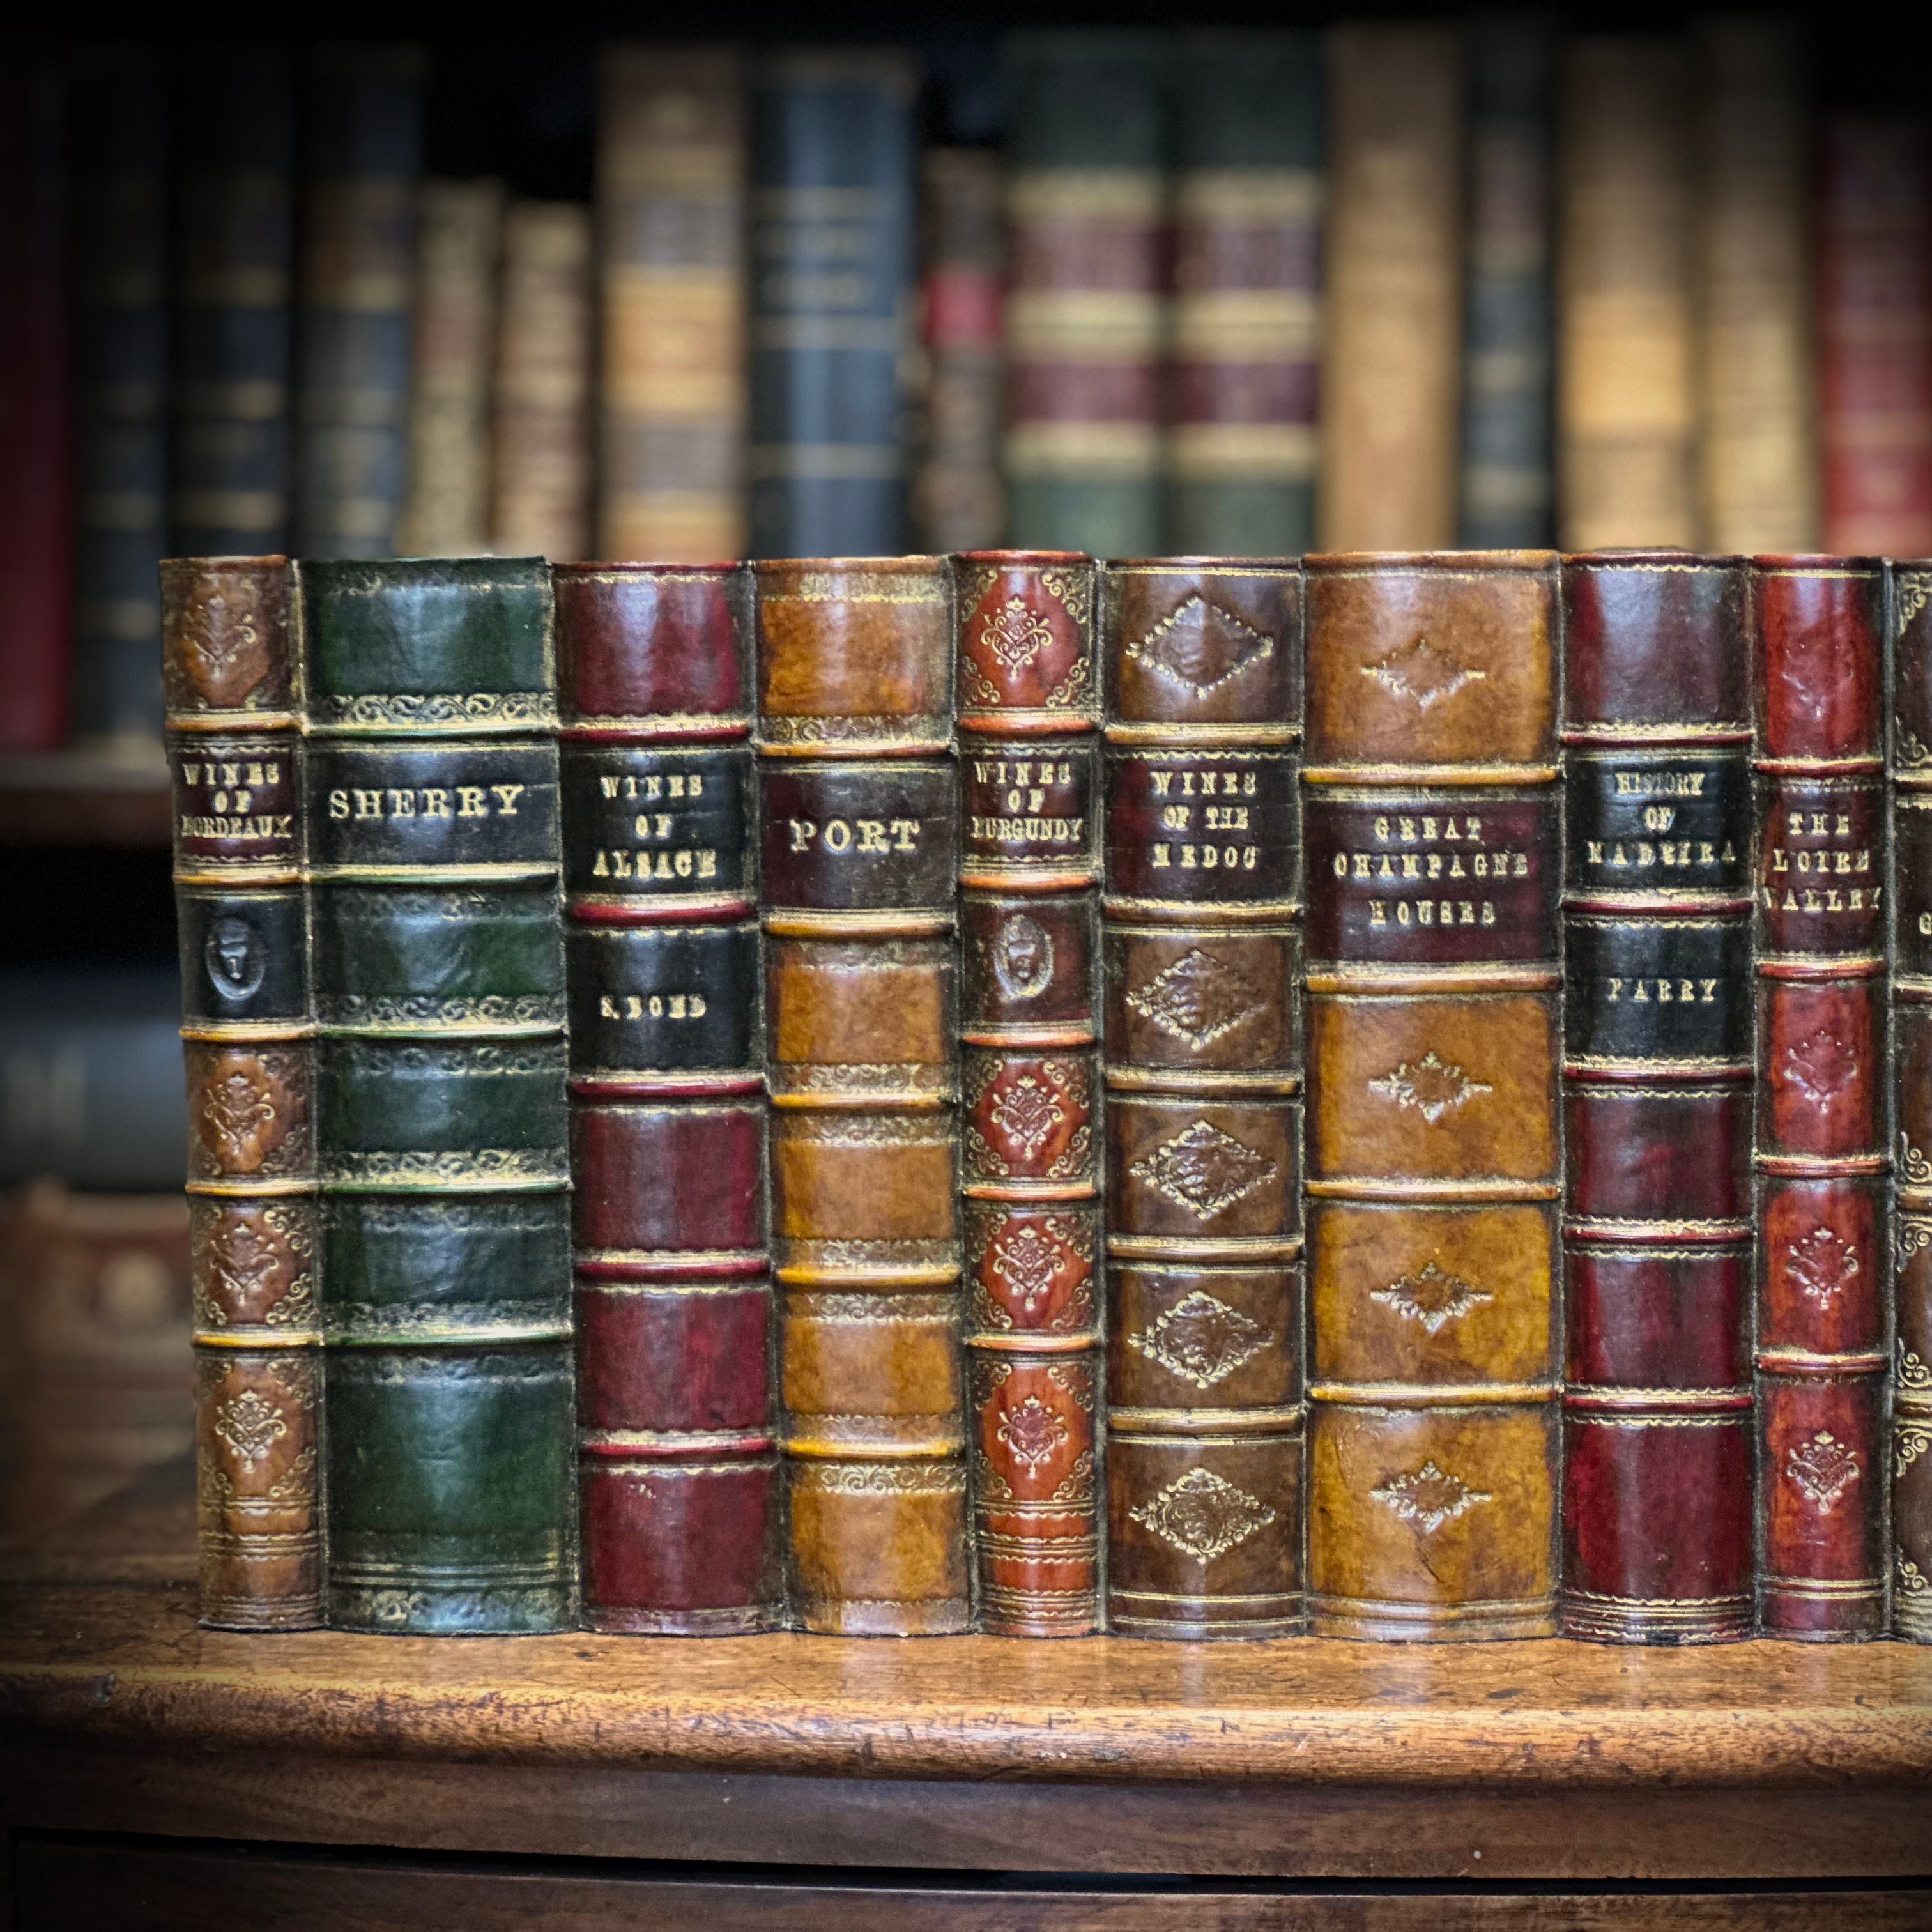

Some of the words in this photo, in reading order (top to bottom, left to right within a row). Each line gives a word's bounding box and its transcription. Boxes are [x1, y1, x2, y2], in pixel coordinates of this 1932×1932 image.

[600, 774, 703, 799] WINES
[974, 762, 1071, 786] WINES
[1150, 771, 1257, 796] WINES
[1615, 772, 1705, 797] HISTORY
[214, 790, 252, 813] OF
[330, 784, 525, 818] SHERRY
[1008, 788, 1045, 813] OF
[635, 813, 673, 838] OF
[1163, 804, 1190, 829] OF
[1206, 805, 1250, 829] THE
[1374, 816, 1482, 841] GREAT
[1644, 806, 1674, 831] OF
[1789, 812, 1850, 835] THE
[789, 818, 921, 852] PORT
[592, 848, 716, 878] ALSACE
[1152, 843, 1260, 869] MEDOC
[1587, 839, 1736, 865] MADEIRA
[1773, 849, 1869, 874] LOIRE
[1334, 852, 1528, 878] CHAMPAGNE
[1369, 900, 1496, 926] HOUSES
[1607, 977, 1717, 1002] PARRY
